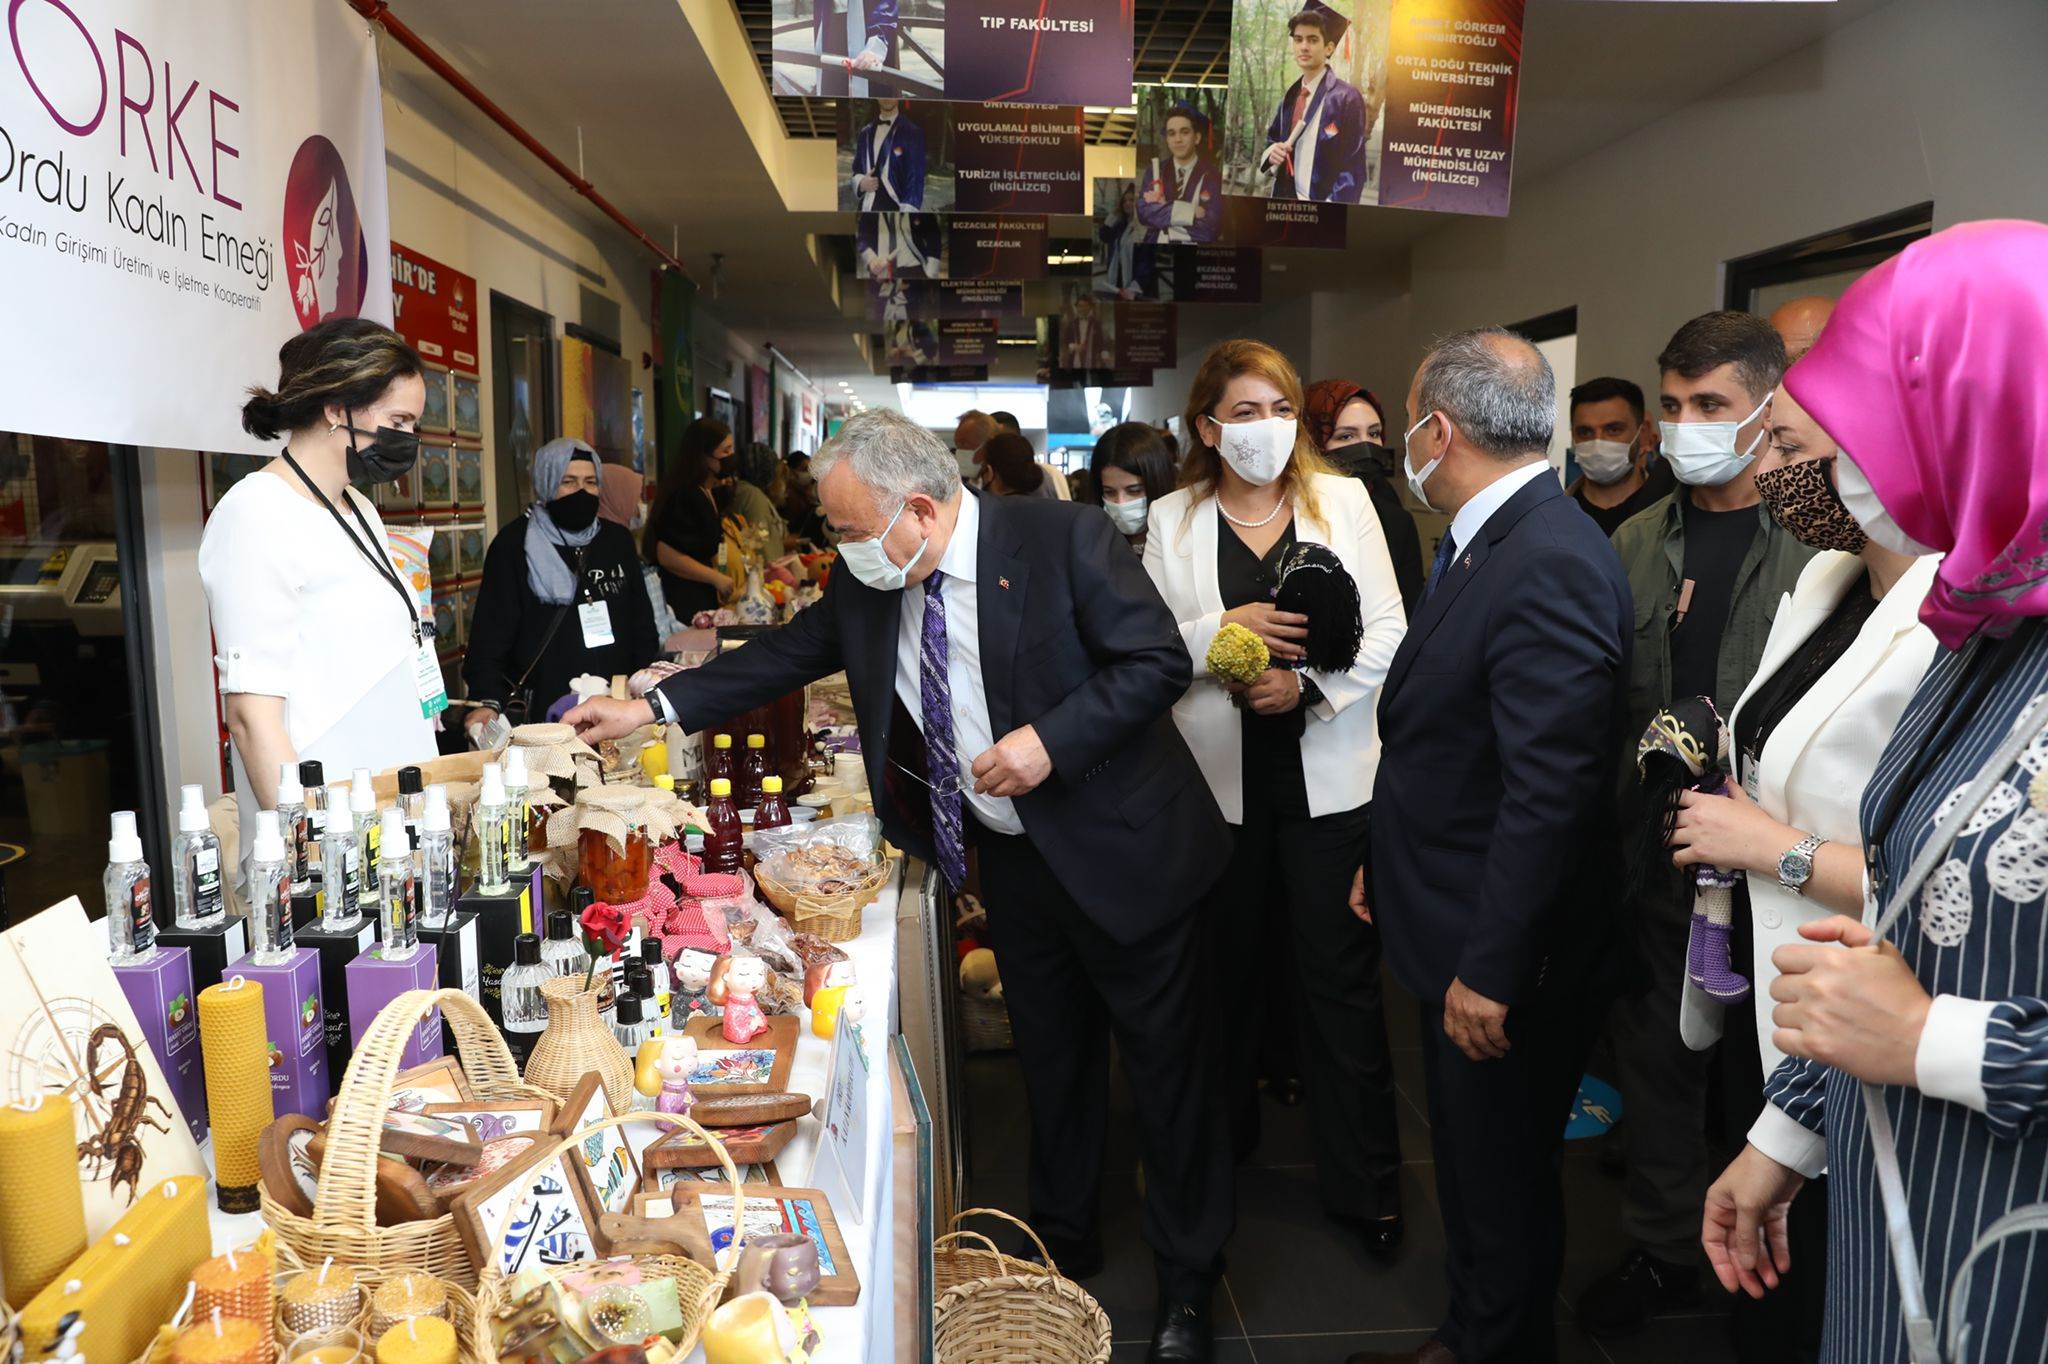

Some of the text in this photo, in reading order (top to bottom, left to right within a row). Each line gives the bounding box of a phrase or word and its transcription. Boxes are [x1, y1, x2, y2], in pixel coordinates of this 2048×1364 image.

[980, 16, 1094, 33] TIP FAKÜLTESİ
[1454, 19, 1506, 35] GÖRKEM
[1395, 55, 1513, 75] ORTA DOĞU TEKNİK
[1411, 70, 1495, 87] ÜNİVERSİTESİ
[8, 0, 242, 211] ORKE
[1409, 102, 1492, 119] MÜHENDİSLİK
[957, 122, 1081, 135] UYGULAMALI BİLİMLER
[1417, 116, 1482, 132] FAKÜLTESİ
[979, 134, 1060, 146] YÜKSEKOKULU
[1389, 142, 1506, 162] HAVACILIK VE UZAY
[1403, 156, 1490, 173] MÜHENDİSLİĞİ
[958, 169, 1081, 181] TURİZM İŞLETMECİLİĞİ
[1412, 171, 1480, 188] (İNGİLİZCE)
[989, 181, 1051, 194] (İNGİLİZCE)
[1266, 202, 1318, 213] İSTATİSTİK
[953, 222, 997, 230] ECZACILIK
[1265, 212, 1319, 224] (İNGİLİZCE)
[108, 171, 187, 251] Kadın
[201, 213, 273, 292] Emeği
[976, 240, 1022, 248] ECZACILIK
[55, 232, 107, 263] Girişimi
[113, 246, 153, 279] Üretimi
[158, 268, 170, 284] ve
[174, 266, 210, 296] İşletme
[214, 283, 262, 312] Kooperatifi
